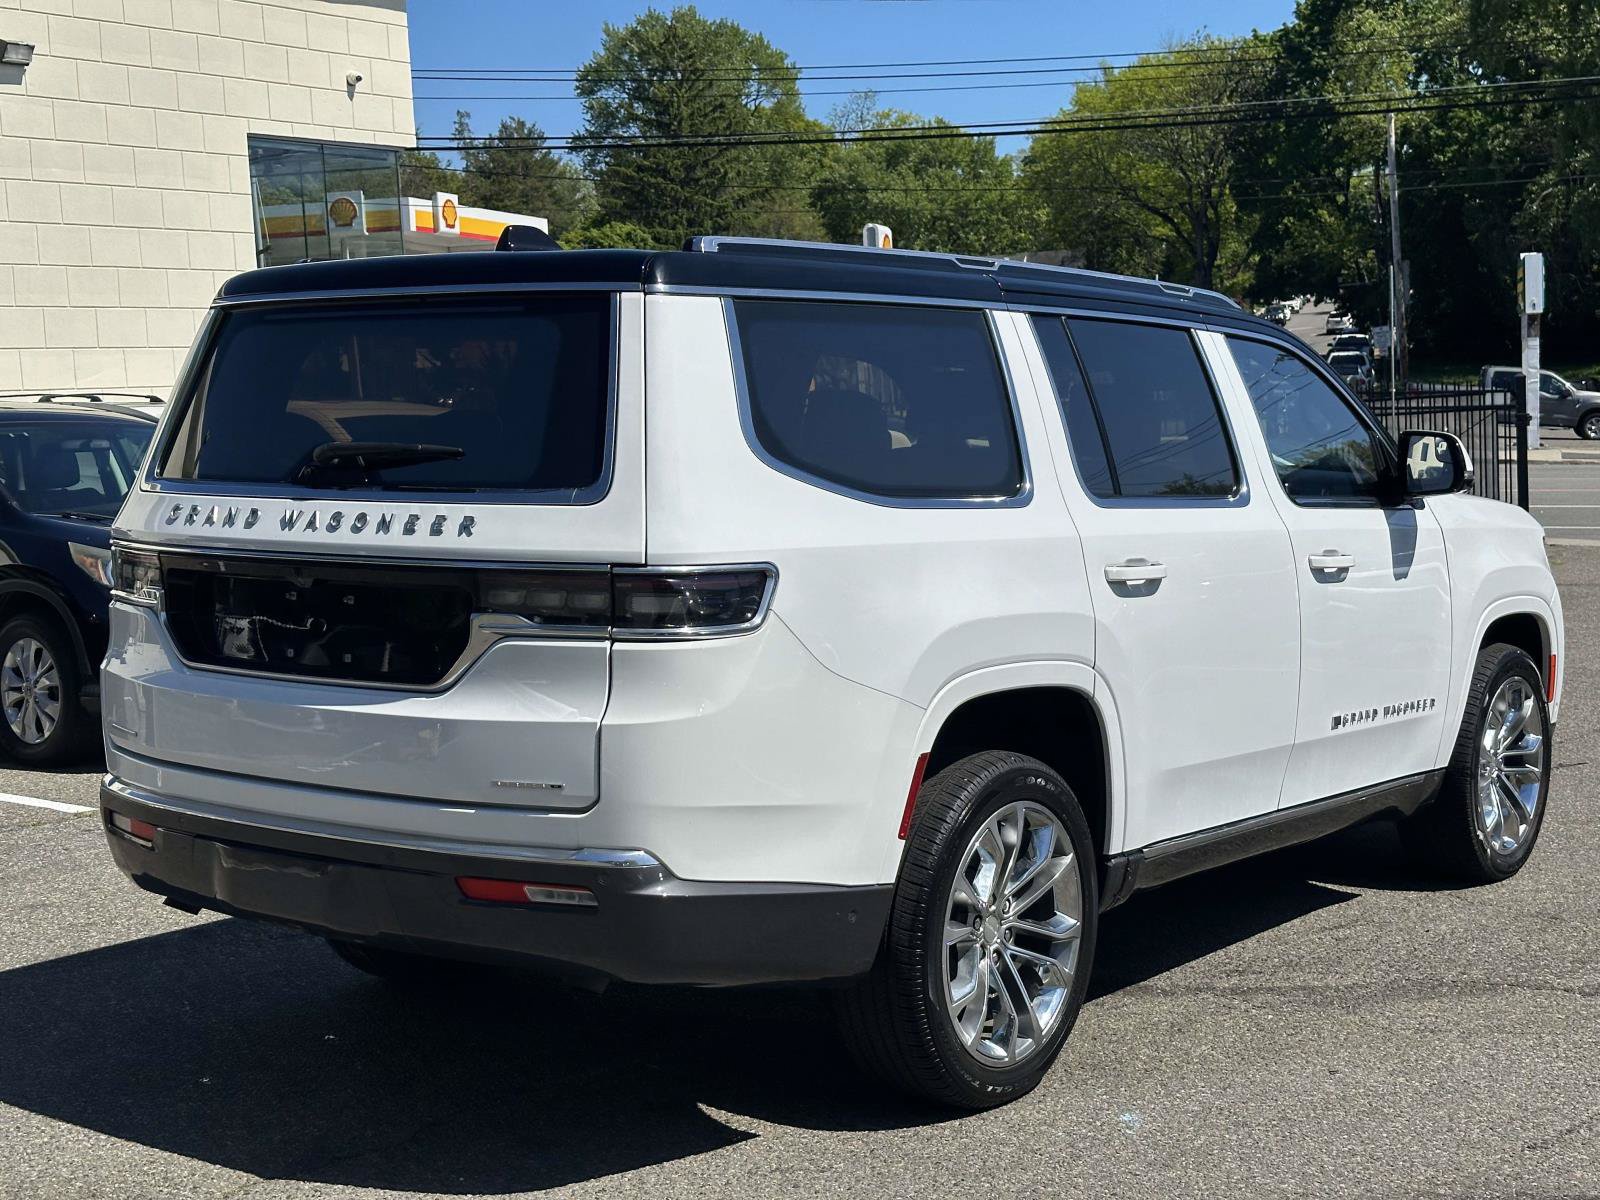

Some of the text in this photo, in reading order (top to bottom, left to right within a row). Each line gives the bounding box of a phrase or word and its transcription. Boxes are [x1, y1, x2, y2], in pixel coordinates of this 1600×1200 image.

[166, 503, 477, 538] GRAND WAGONEER
[1342, 698, 1436, 728] GRAND WAGONEER
